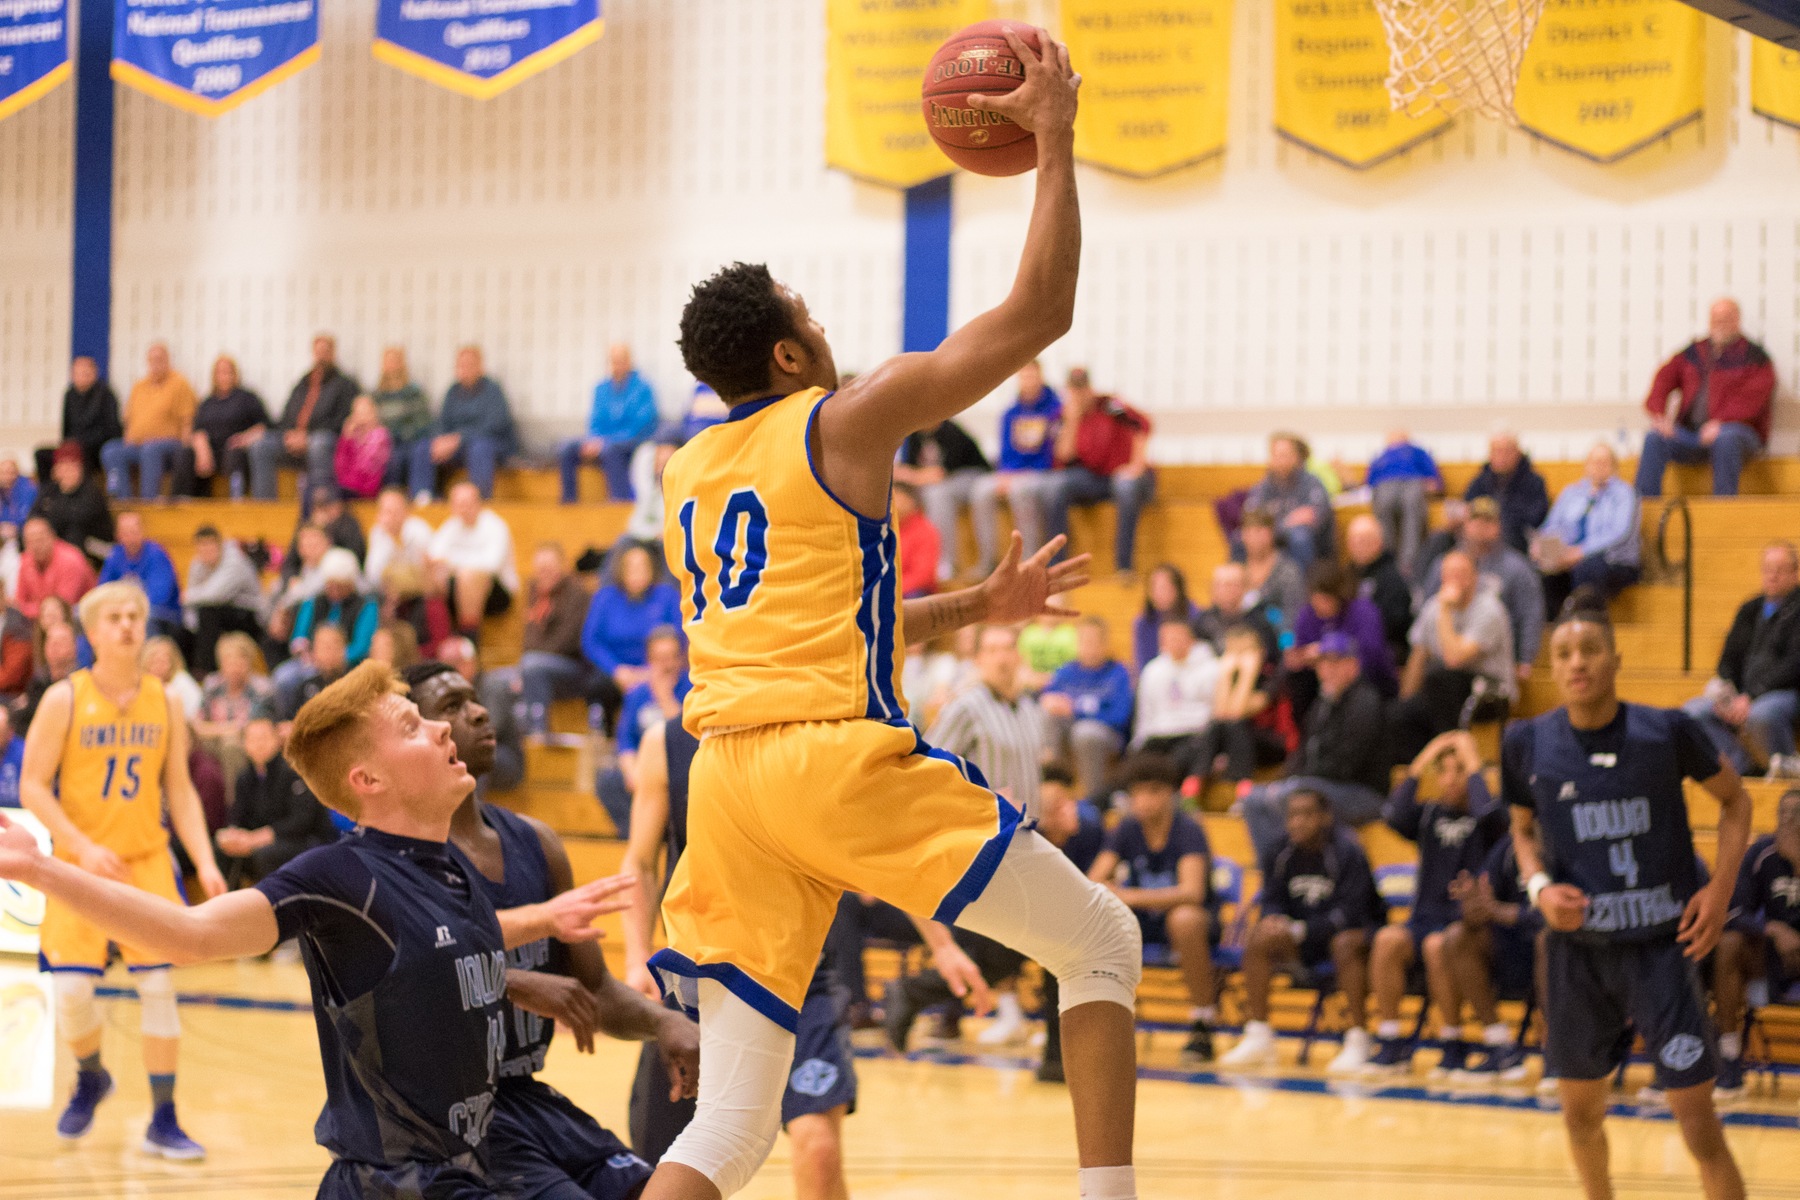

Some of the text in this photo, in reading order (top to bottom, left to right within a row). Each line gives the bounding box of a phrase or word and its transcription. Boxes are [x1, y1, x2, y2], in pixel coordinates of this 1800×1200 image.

[678, 485, 772, 627] 10
[100, 754, 142, 801] 15
[1572, 797, 1652, 843] IOWA
[1608, 838, 1640, 888] 4
